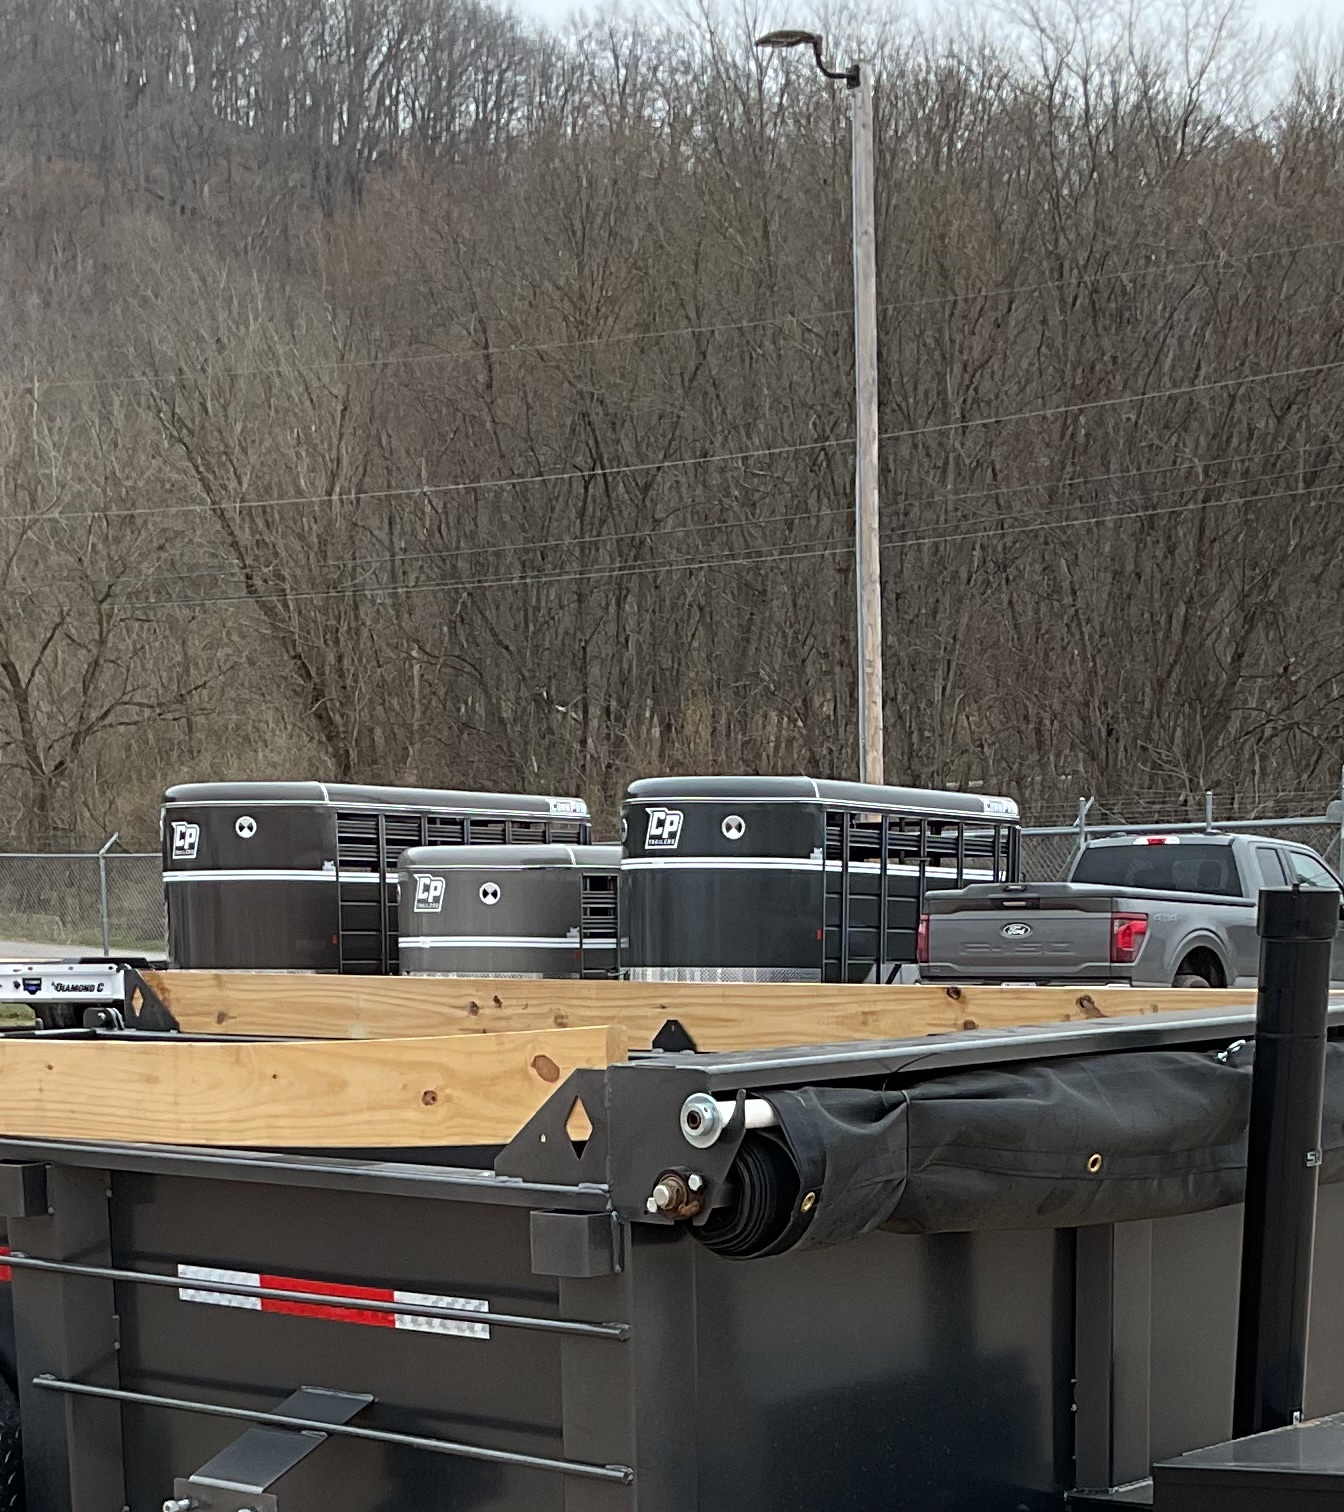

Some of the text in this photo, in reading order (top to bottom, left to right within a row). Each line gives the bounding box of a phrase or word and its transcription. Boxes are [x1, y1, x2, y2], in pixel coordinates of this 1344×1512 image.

[174, 824, 197, 849] CP
[650, 810, 680, 838] CP
[418, 877, 443, 902] CP
